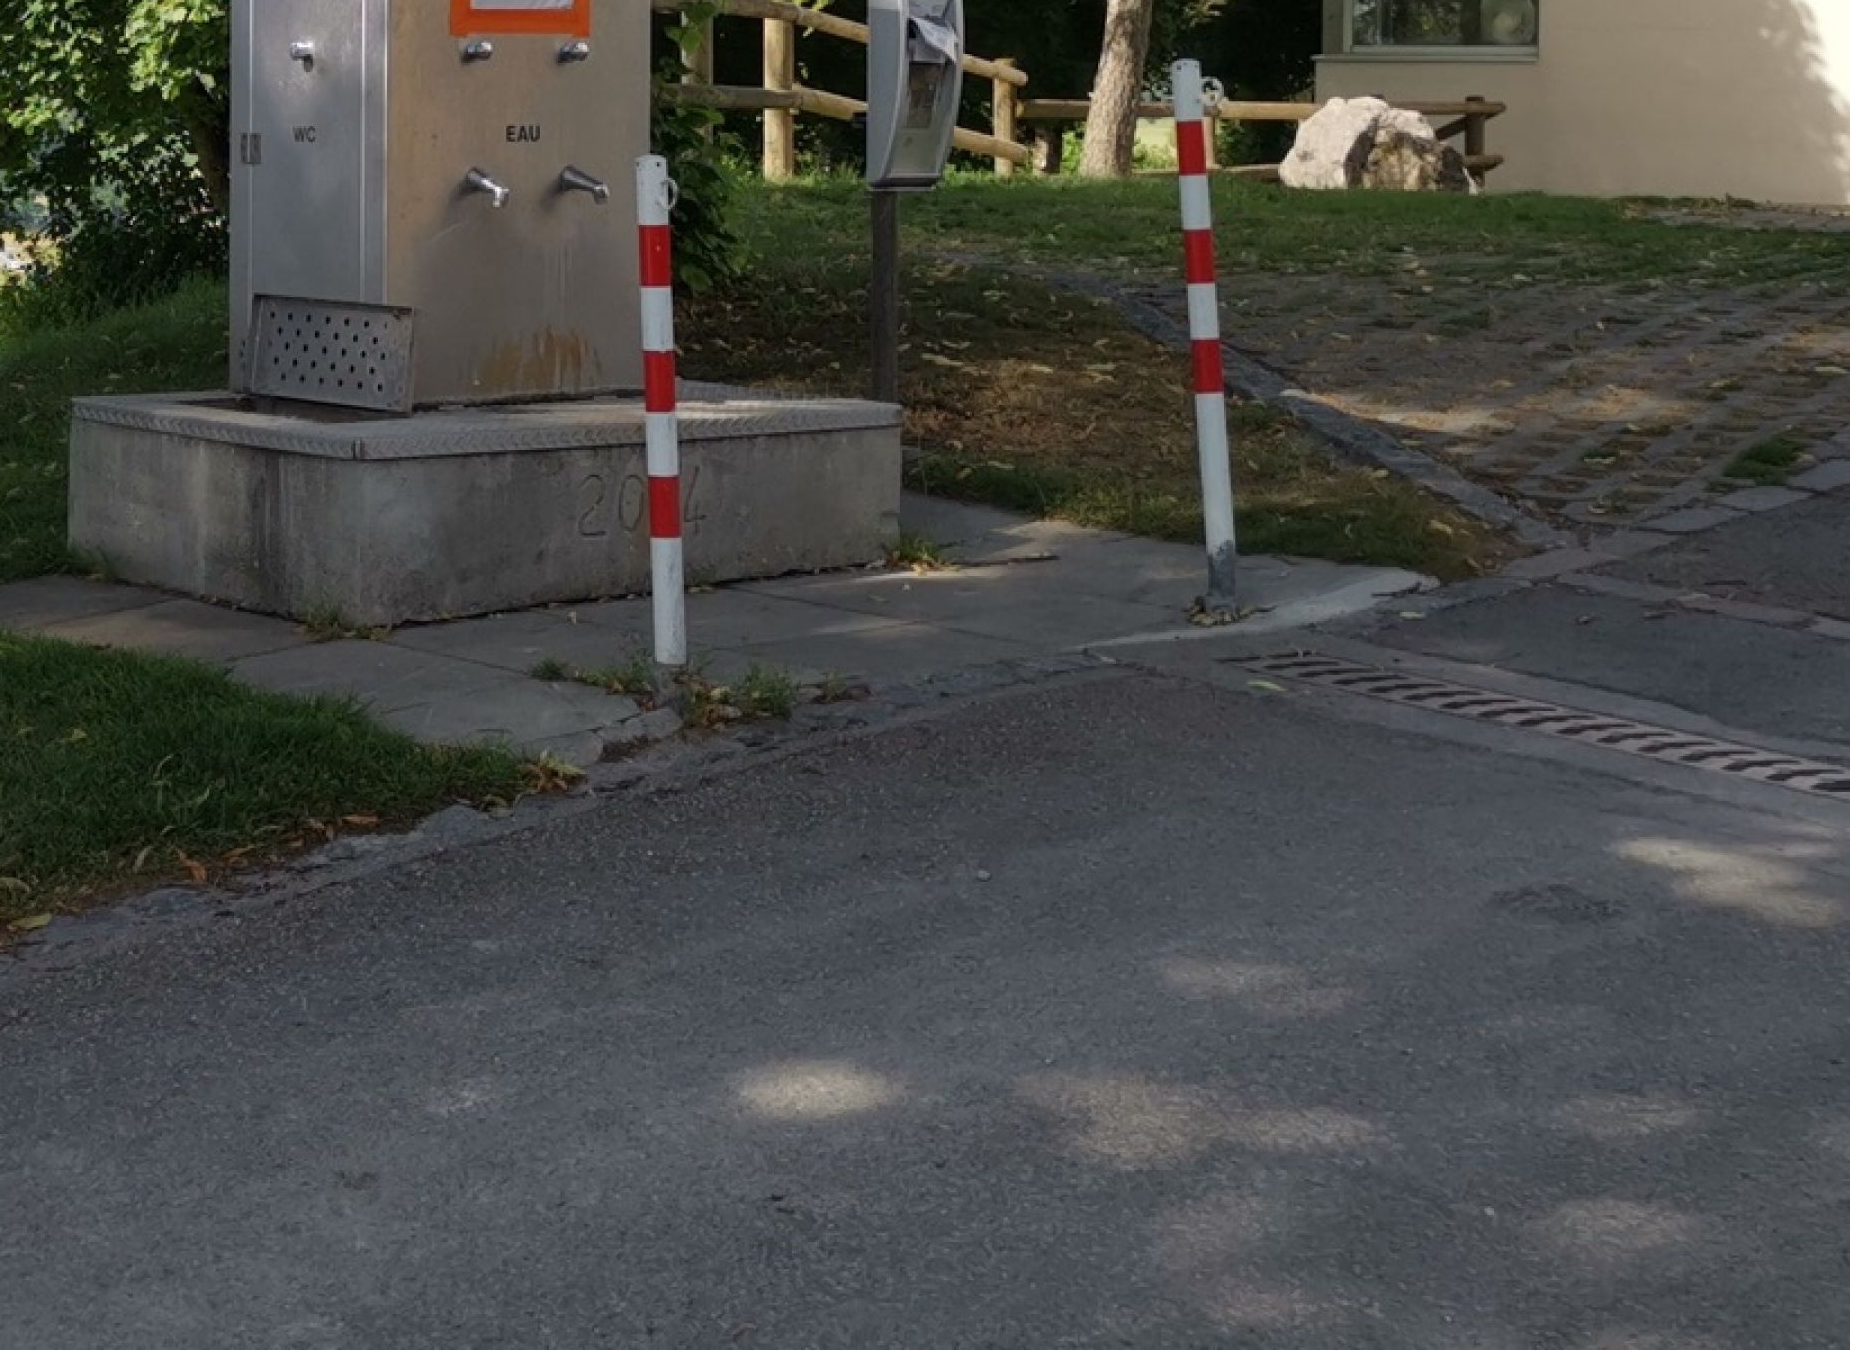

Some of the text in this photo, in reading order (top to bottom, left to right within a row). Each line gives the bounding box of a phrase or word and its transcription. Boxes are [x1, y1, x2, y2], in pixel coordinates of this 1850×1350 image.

[292, 125, 316, 143] WC
[505, 125, 541, 143] EAU
[577, 465, 707, 538] 204
